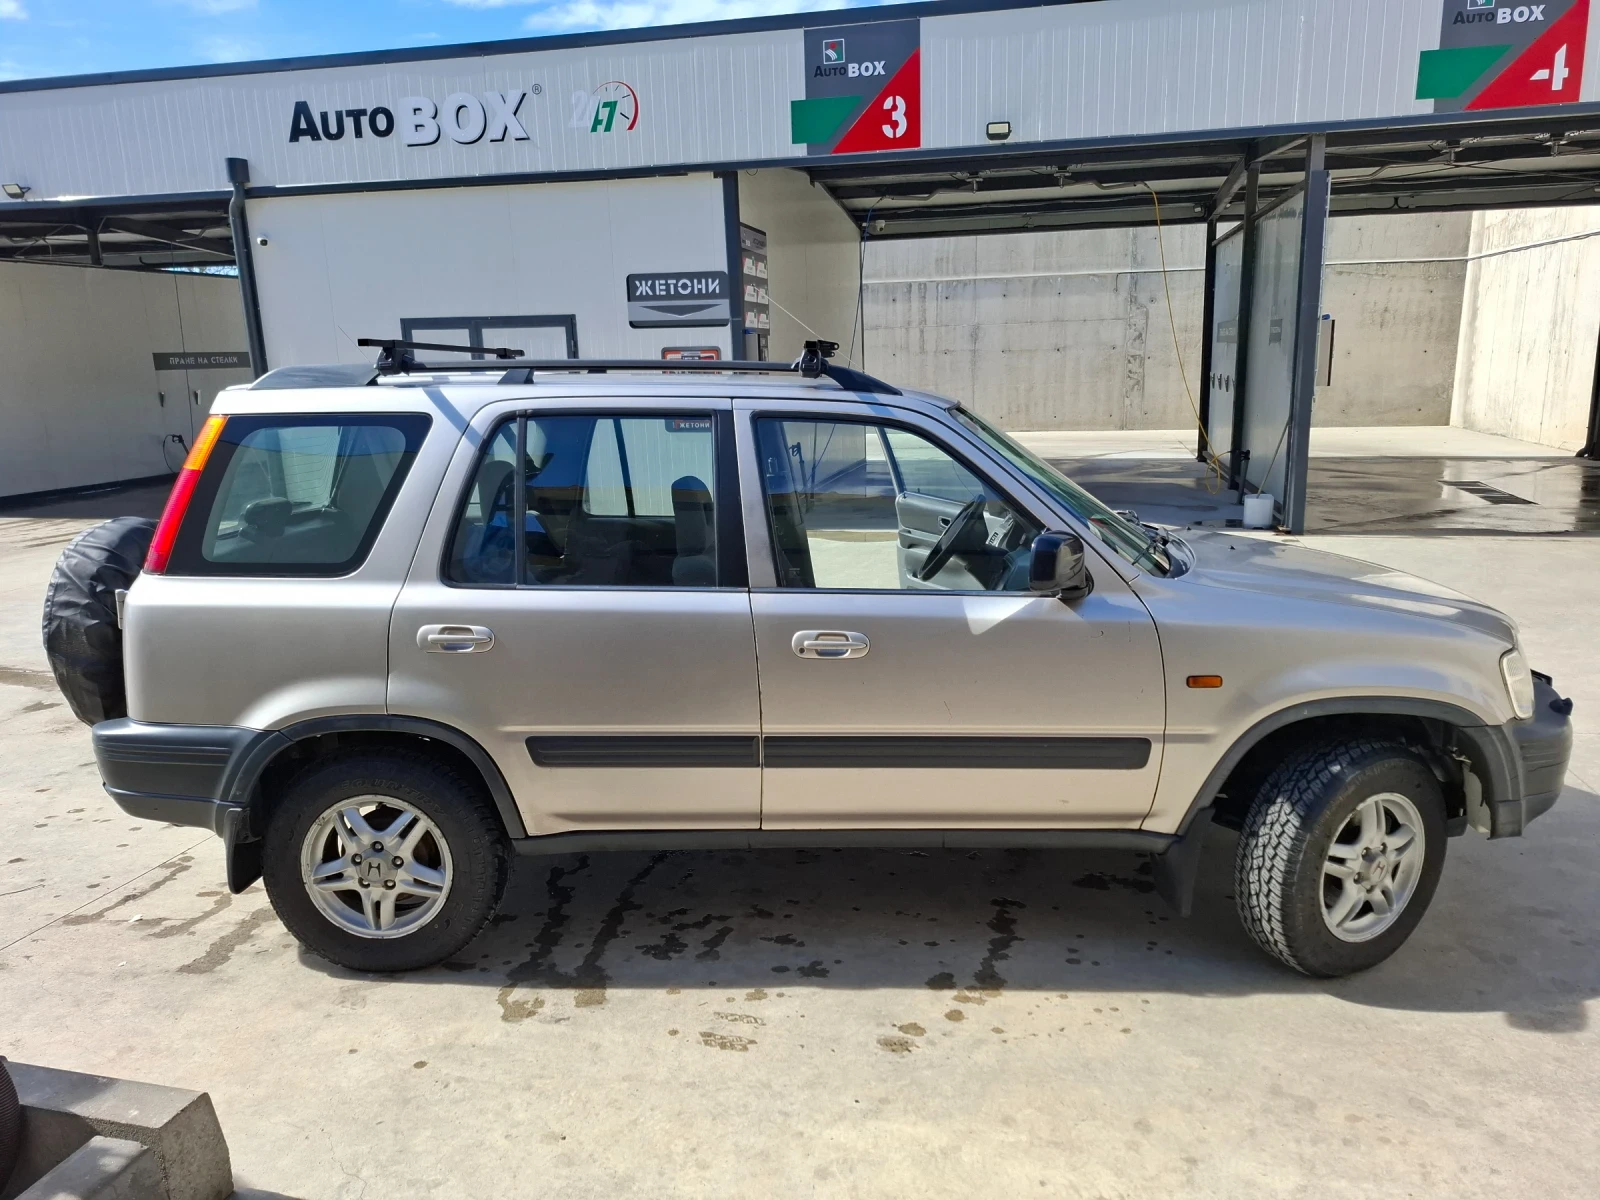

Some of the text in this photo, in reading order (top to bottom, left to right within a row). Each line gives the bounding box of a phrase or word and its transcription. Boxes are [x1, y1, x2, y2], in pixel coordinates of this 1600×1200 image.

[1529, 43, 1569, 91] 4
[881, 95, 908, 139] 3
[635, 278, 720, 296] ЖЕТОНИ
[169, 356, 238, 365] ПРАНЕ НА СТЕЛКИ
